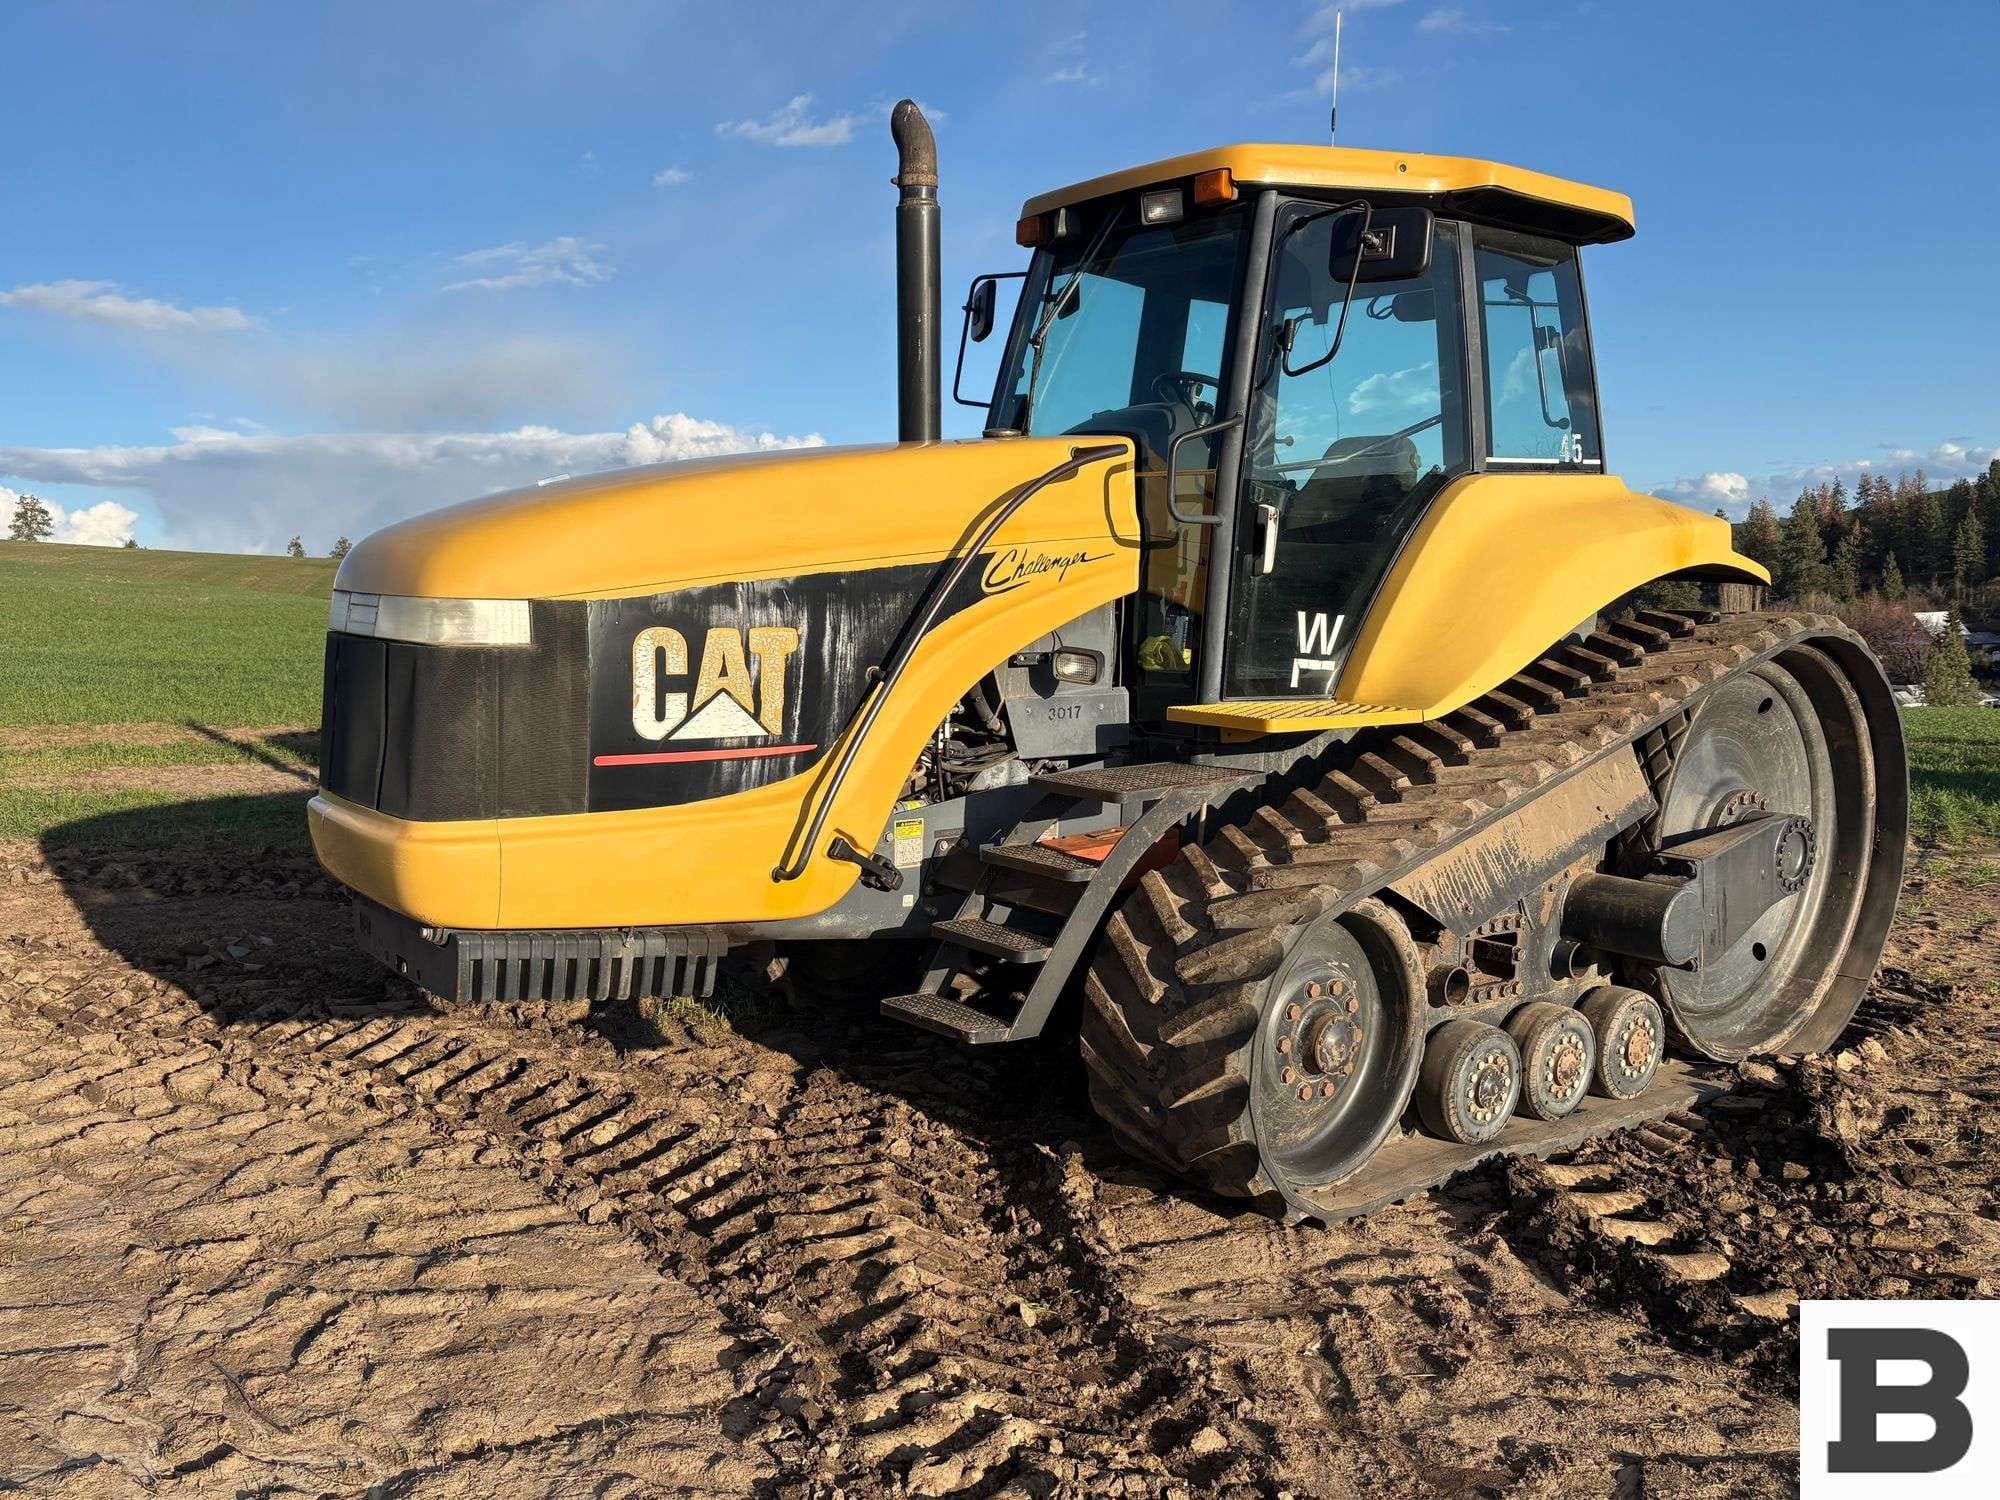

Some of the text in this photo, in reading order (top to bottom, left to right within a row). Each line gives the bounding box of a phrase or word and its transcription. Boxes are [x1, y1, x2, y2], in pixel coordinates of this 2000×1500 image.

[984, 548, 1115, 588] Challenger
[632, 626, 799, 741] CAT
[1048, 705, 1081, 721] 3017
